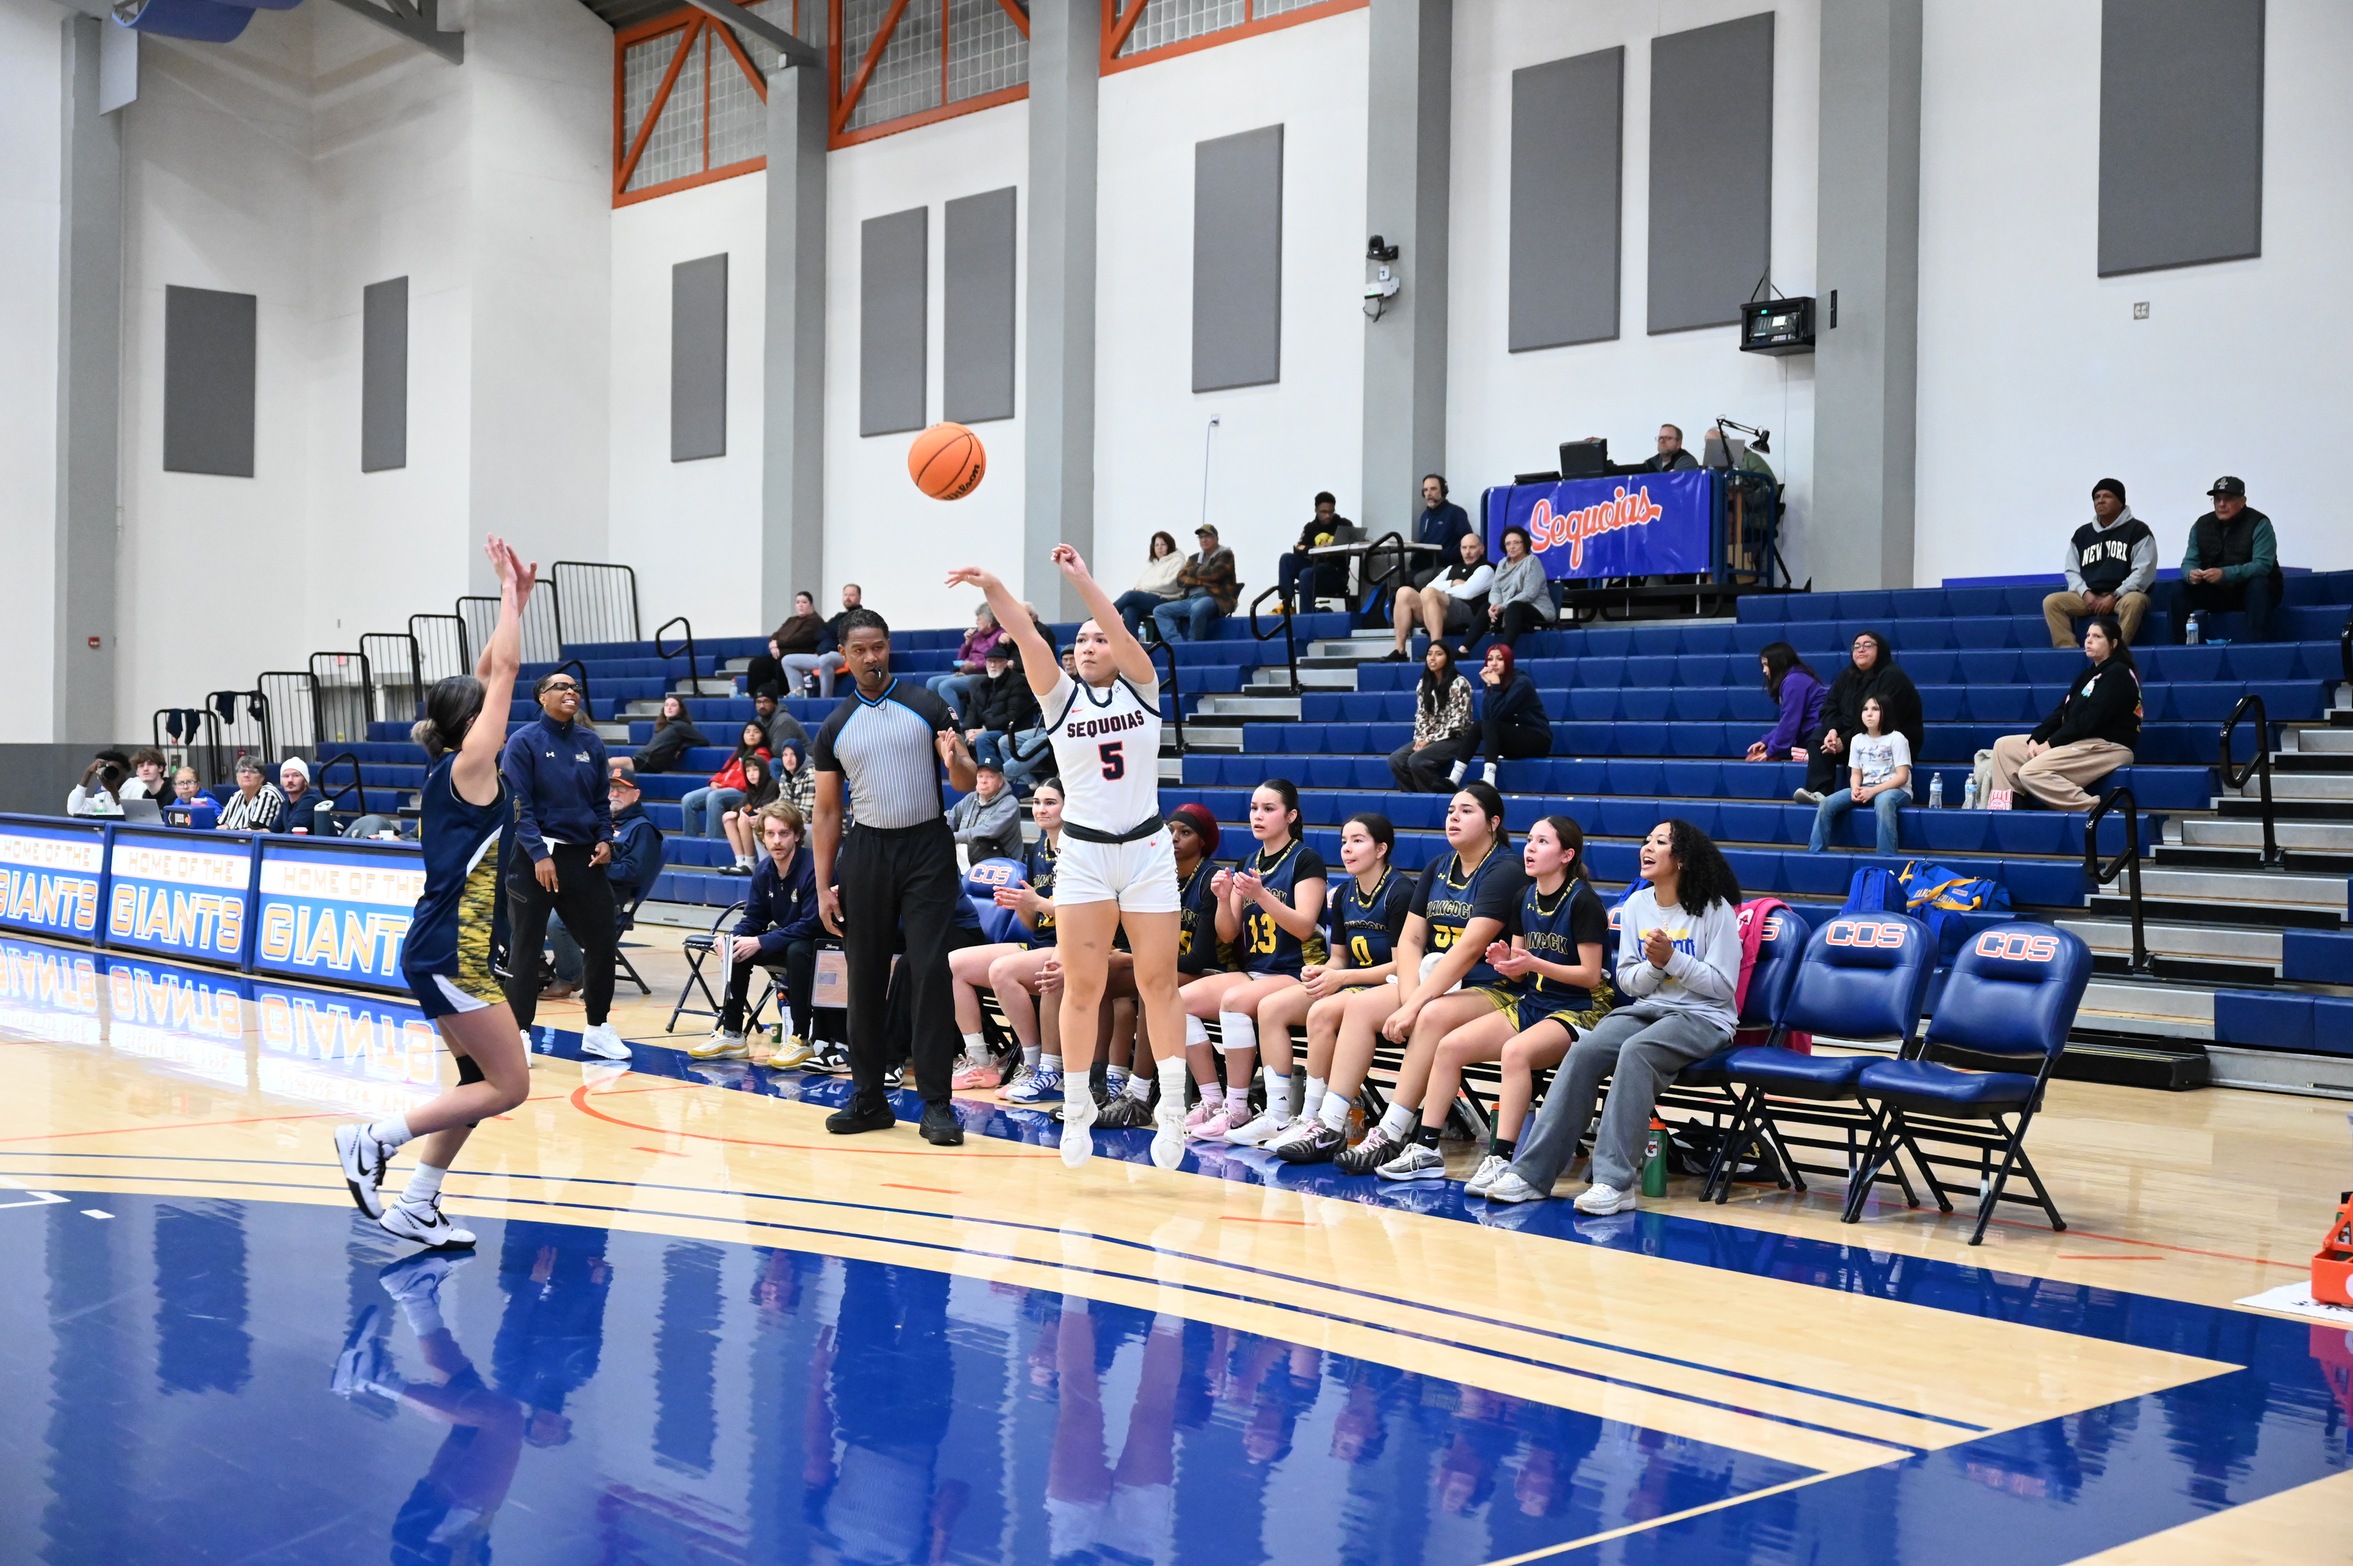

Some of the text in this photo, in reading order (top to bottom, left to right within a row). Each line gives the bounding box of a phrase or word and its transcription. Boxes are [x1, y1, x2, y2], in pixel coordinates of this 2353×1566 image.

[942, 464, 980, 501] Wilson
[1530, 485, 1663, 570] Sequoias
[2082, 540, 2128, 567] NEW YORK
[1067, 710, 1145, 738] SEQUOIAS
[1098, 740, 1125, 781] 5
[4, 839, 91, 867] HOME OF THE
[129, 851, 234, 883] HOME OF THE
[283, 866, 424, 900] HOME OF THE
[969, 863, 1014, 885] COS
[110, 883, 244, 954] GIANTS
[1248, 913, 1277, 954] 13
[261, 902, 415, 977] GIANT
[1351, 935, 1373, 967] 0
[1826, 921, 1908, 949] COS
[1975, 931, 2060, 962] COS
